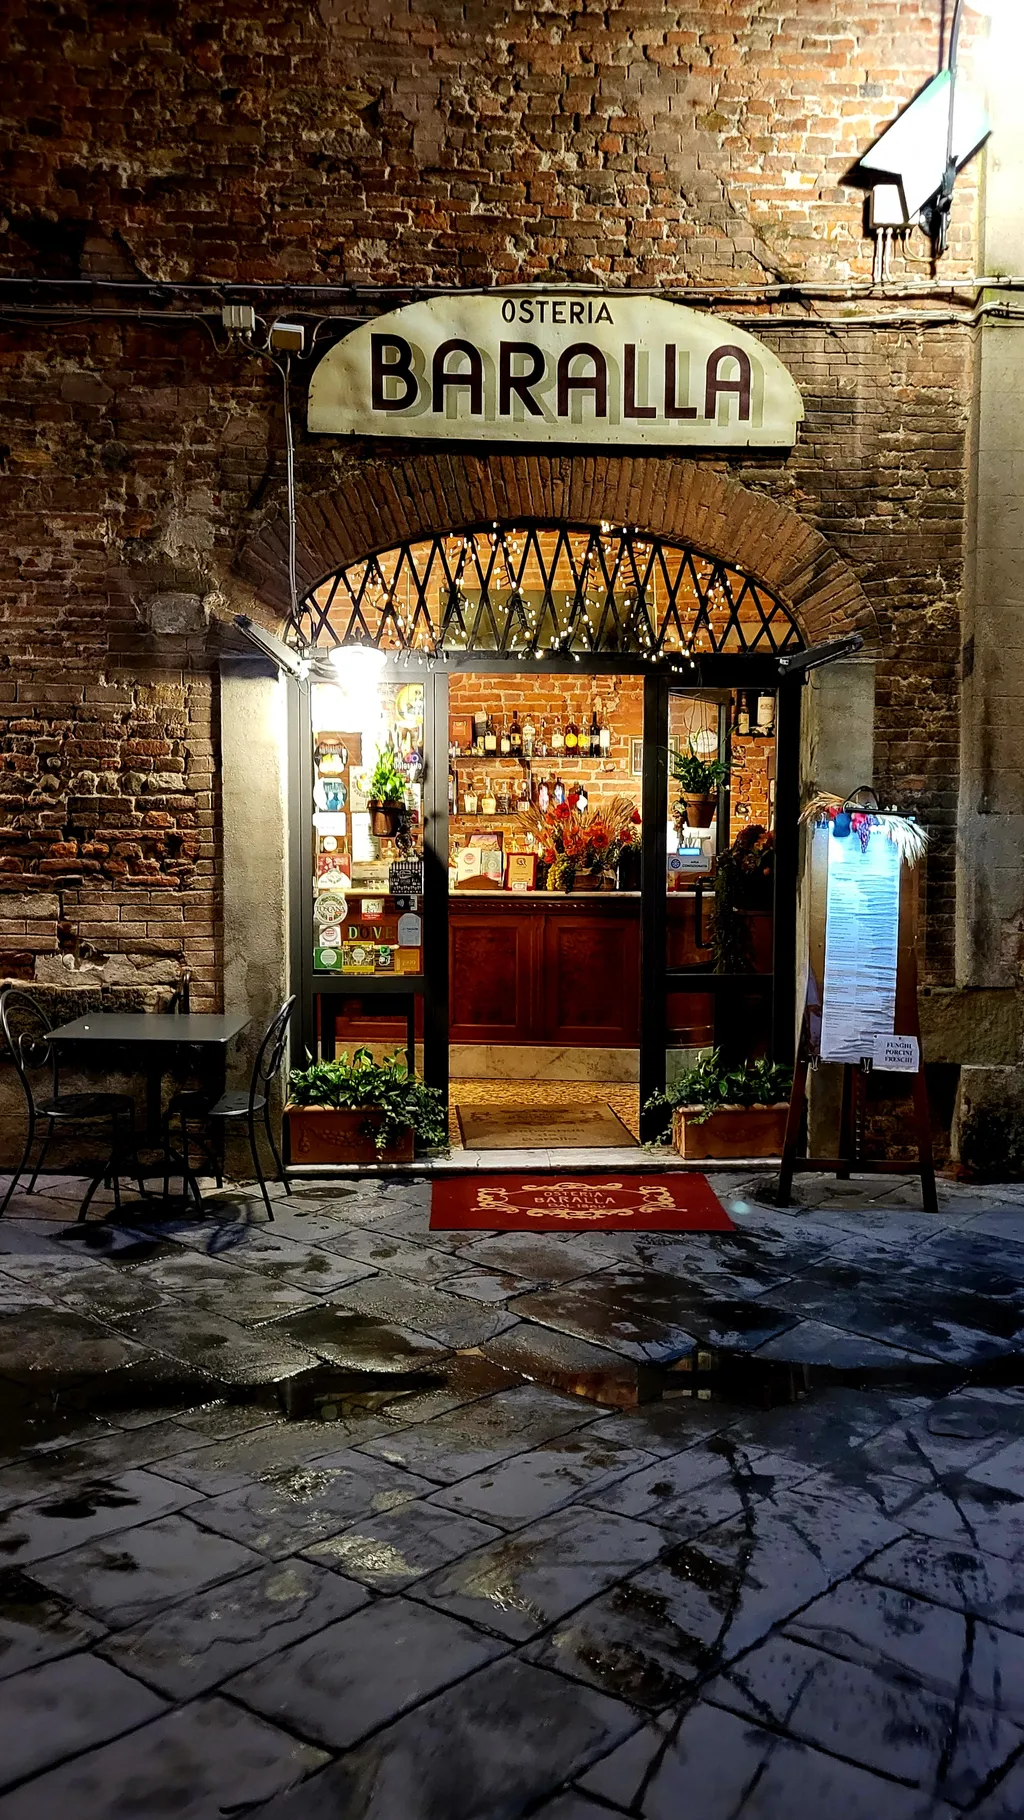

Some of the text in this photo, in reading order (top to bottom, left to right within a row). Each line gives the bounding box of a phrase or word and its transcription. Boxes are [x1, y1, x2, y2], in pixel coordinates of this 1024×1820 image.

[501, 298, 614, 325] OSTERIA
[371, 333, 752, 421] BARALLA
[884, 1056, 913, 1064] FRESCHI
